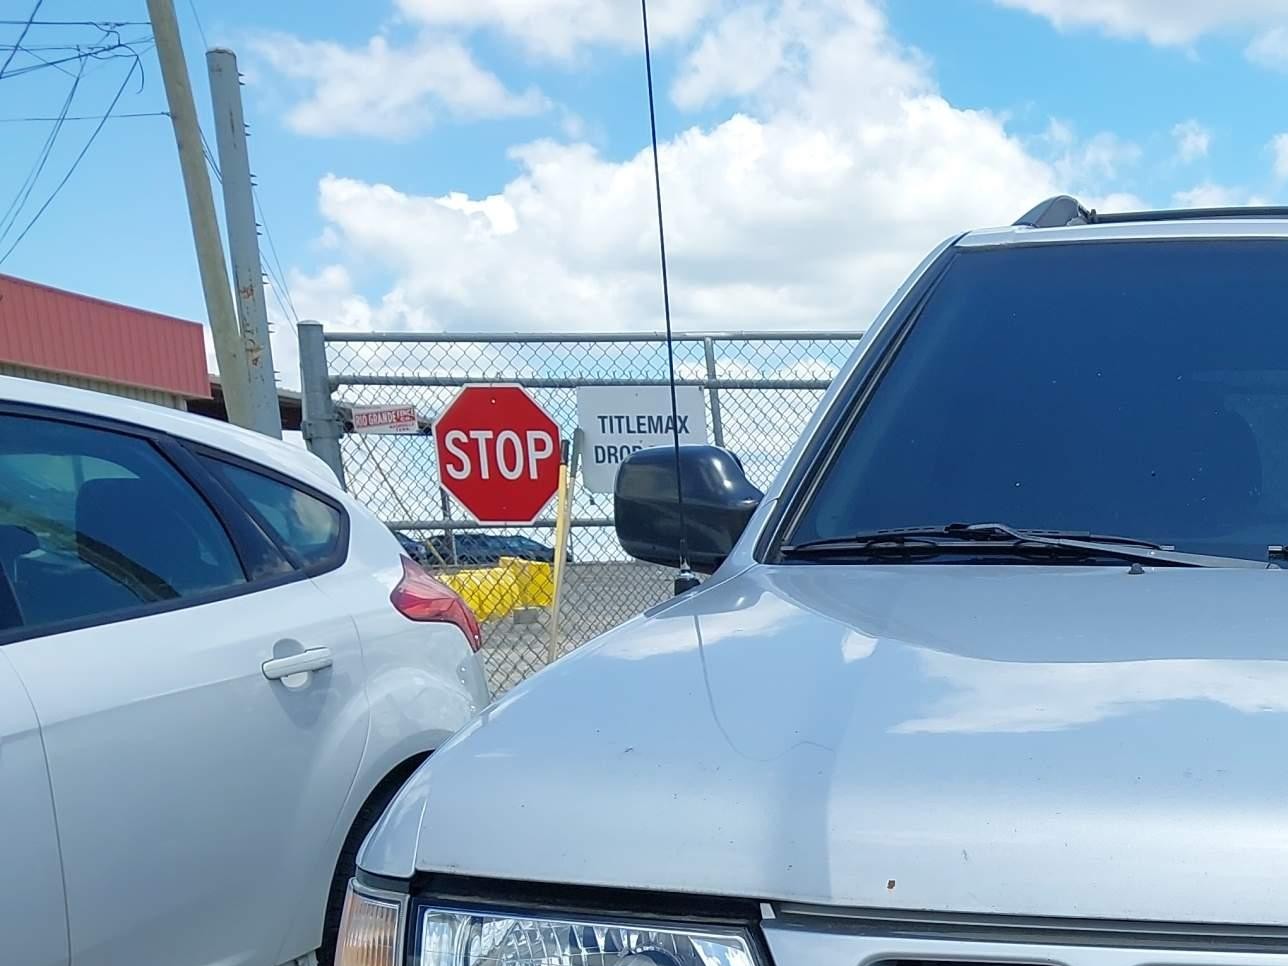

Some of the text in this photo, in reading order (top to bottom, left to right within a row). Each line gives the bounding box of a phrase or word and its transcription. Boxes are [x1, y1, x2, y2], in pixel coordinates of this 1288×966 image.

[368, 411, 397, 426] GRANDE
[597, 415, 690, 434] TITLEMAX
[445, 430, 553, 480] STOP
